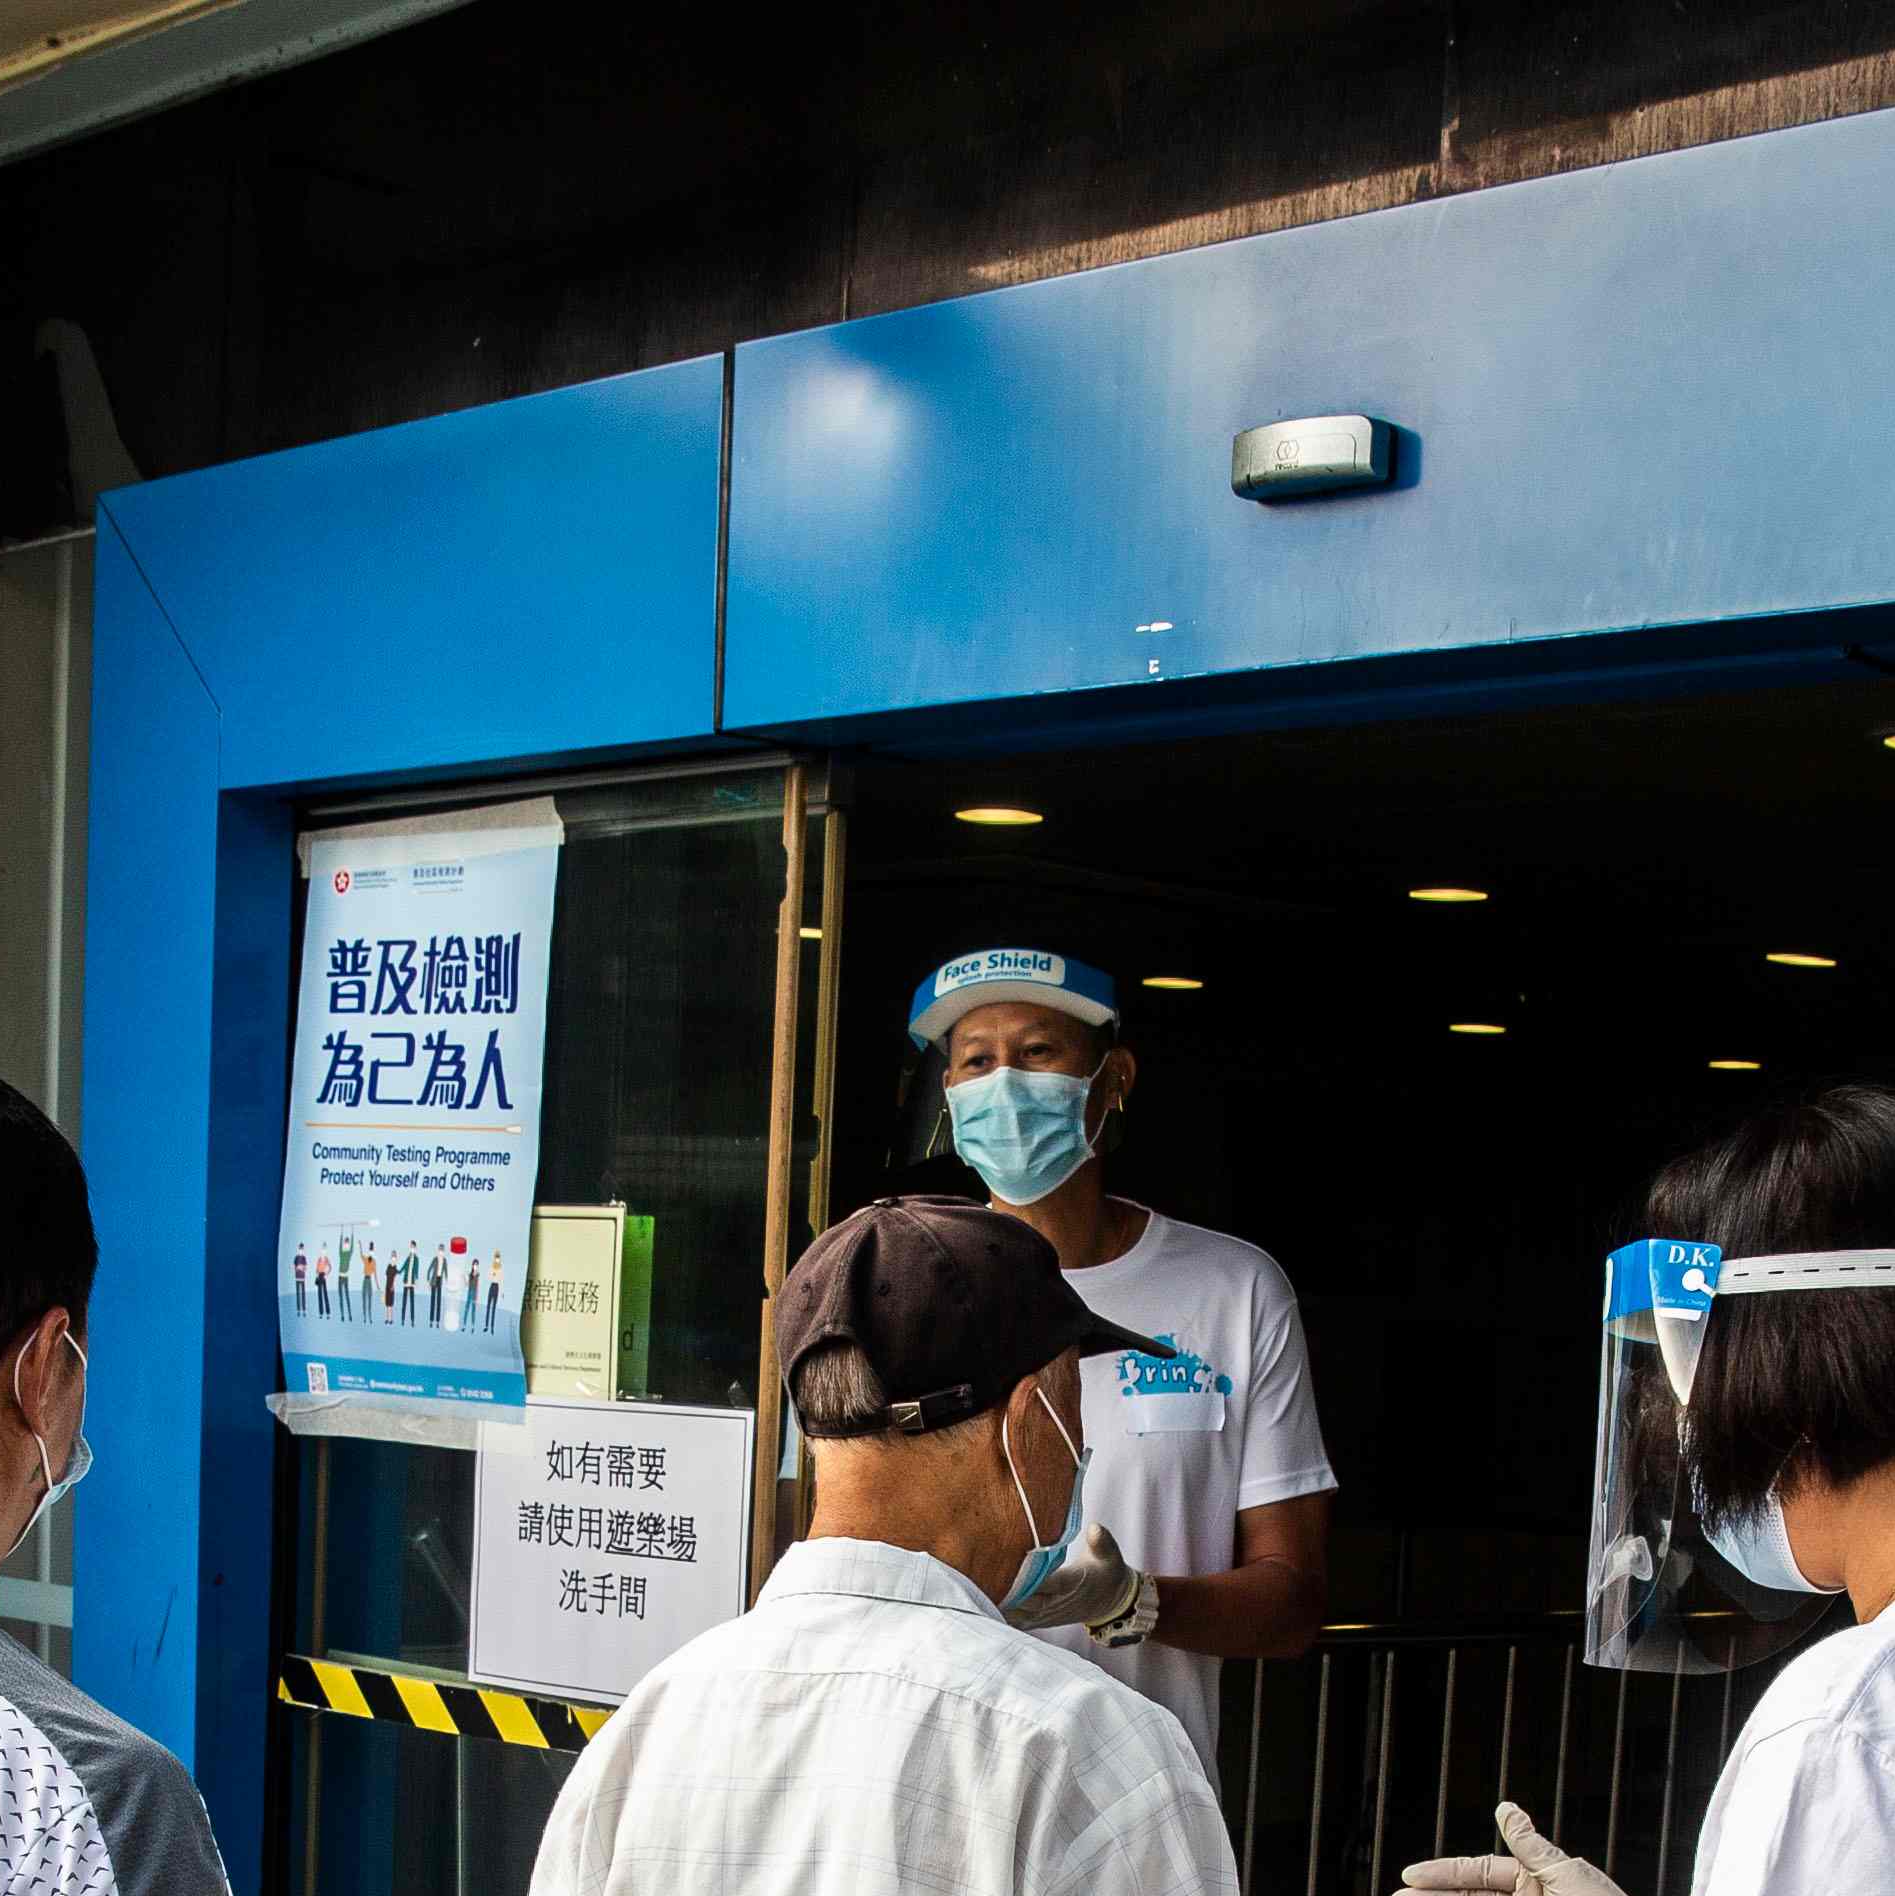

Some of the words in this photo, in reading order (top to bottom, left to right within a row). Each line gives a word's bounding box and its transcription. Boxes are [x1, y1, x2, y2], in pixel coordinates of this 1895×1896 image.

[326, 932, 522, 1015] 普及檢測
[943, 959, 981, 981] Face
[987, 952, 1052, 972] Shield
[316, 1028, 514, 1110] 為己為人
[312, 1142, 383, 1165] Community
[386, 1144, 431, 1167] Testing
[435, 1146, 511, 1168] Programme
[320, 1167, 364, 1187] Protect
[368, 1170, 419, 1188] Yourself
[422, 1172, 447, 1190] and
[450, 1172, 496, 1192] Others
[1668, 1244, 1714, 1267] D.K.
[546, 1440, 667, 1491] 如有需要
[517, 1500, 698, 1562] 請使用遊樂場
[558, 1569, 648, 1620] 洗手間
